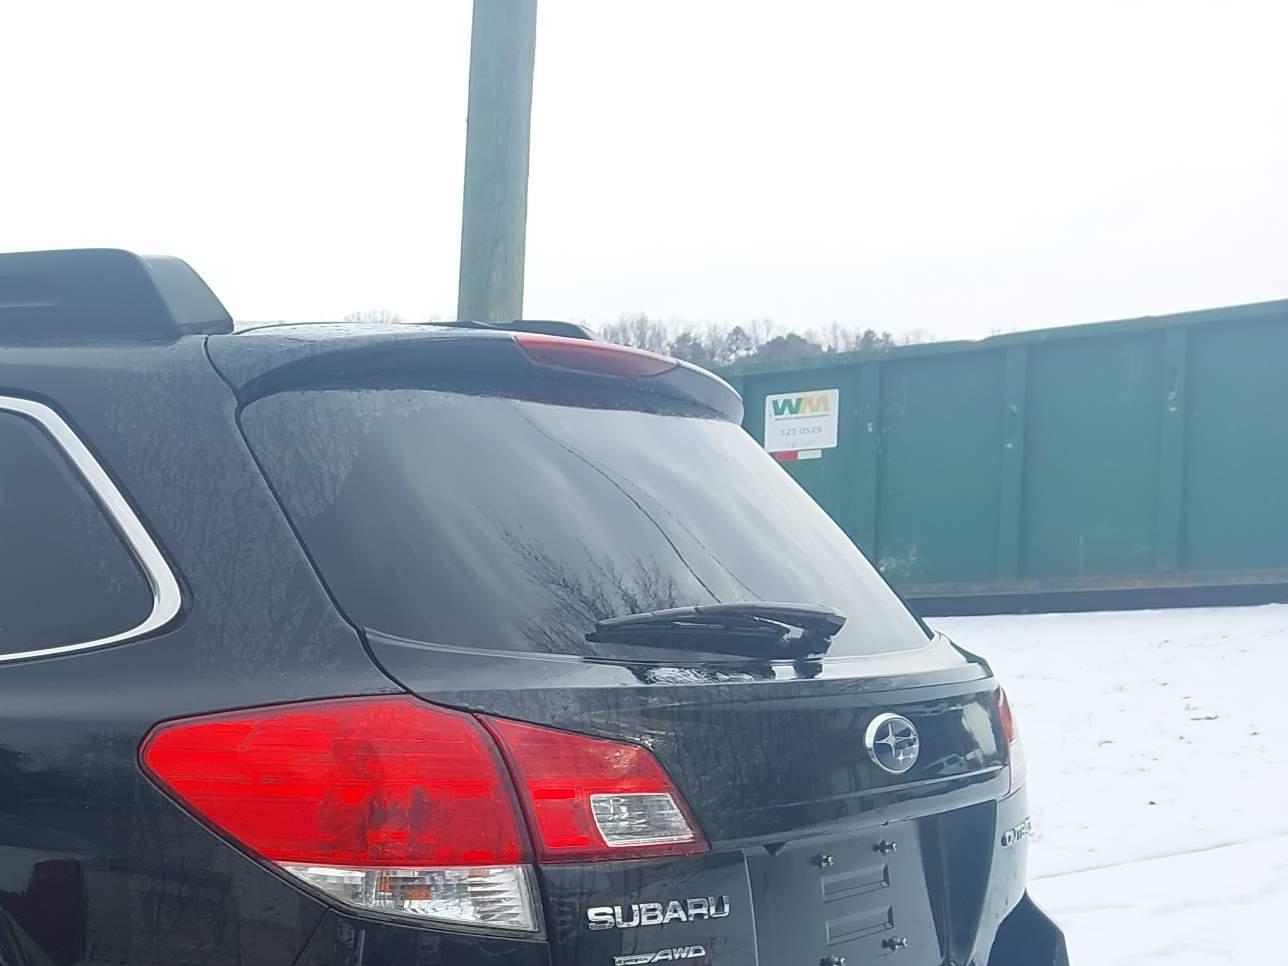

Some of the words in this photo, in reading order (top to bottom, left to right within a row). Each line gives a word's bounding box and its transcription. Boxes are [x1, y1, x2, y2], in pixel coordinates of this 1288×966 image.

[772, 395, 830, 416] WM
[587, 895, 730, 931] SUBARU
[650, 945, 706, 963] AWD
